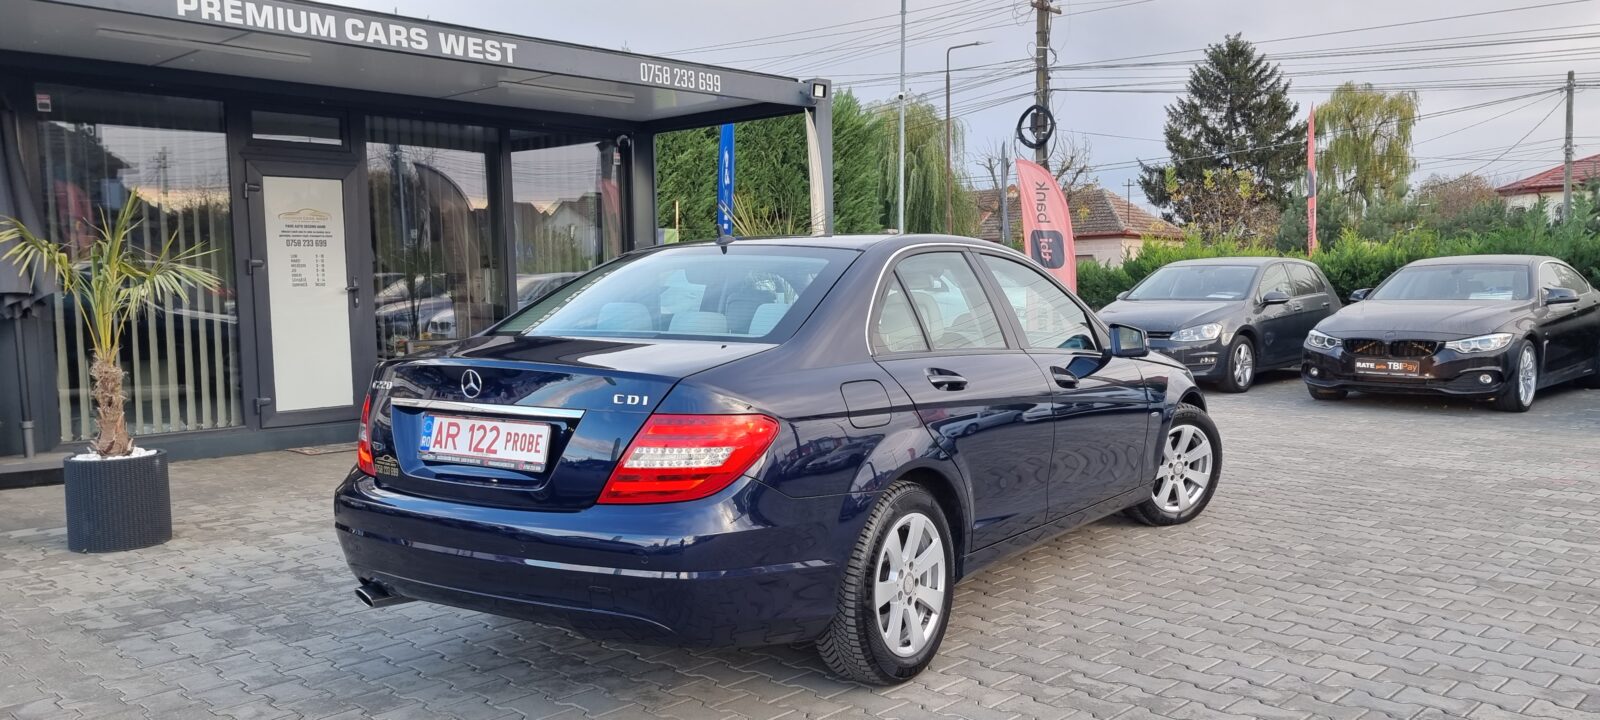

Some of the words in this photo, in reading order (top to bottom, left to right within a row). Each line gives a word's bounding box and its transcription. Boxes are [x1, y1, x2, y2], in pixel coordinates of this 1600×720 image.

[176, 0, 337, 39] PREMIUM
[344, 17, 429, 50] CARS
[438, 31, 517, 64] WEST
[640, 62, 671, 85] 0758
[673, 68, 695, 88] 233
[698, 72, 721, 93] 699
[286, 239, 302, 247] 0758
[302, 239, 314, 247] 233
[1356, 361, 1375, 369] RATE
[613, 393, 649, 406] CDI
[421, 435, 431, 447] RO
[433, 421, 461, 450] AR
[468, 423, 501, 455] 122
[504, 431, 543, 454] PROBE
